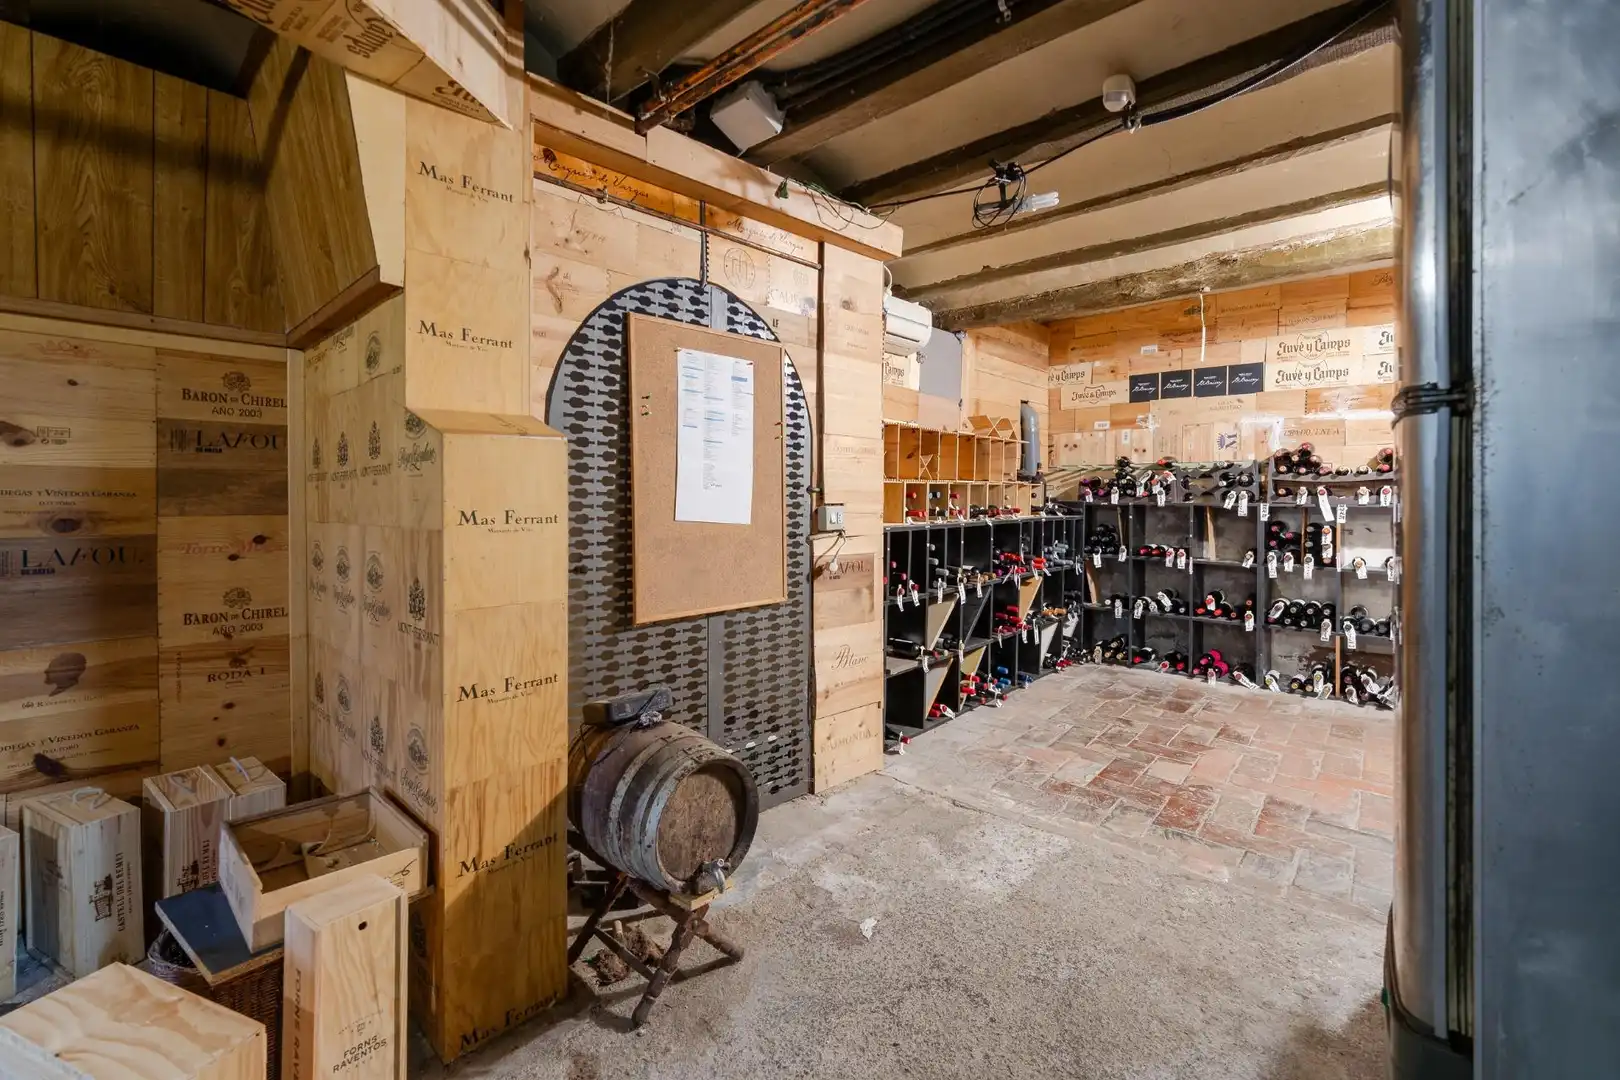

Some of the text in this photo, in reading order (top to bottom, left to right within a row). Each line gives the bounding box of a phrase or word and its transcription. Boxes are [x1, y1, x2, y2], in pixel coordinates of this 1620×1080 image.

[418, 160, 454, 185] Mas
[460, 174, 514, 203] Ferrant
[418, 319, 454, 340] Mas
[461, 327, 514, 349] Ferrant
[1276, 337, 1351, 357] Juvé y Camps
[1061, 369, 1086, 382] Camps
[1275, 369, 1303, 384] Juvé
[1304, 371, 1311, 382] y
[1313, 366, 1350, 381] Camps
[181, 388, 229, 404] BARON
[240, 393, 288, 409] CHIREL
[211, 406, 263, 419] AÑO 2003
[457, 509, 559, 526] Mas Ferrant
[183, 611, 229, 626] BARON
[241, 607, 289, 621] CHIREL
[212, 622, 264, 636] AÑO 2003
[832, 643, 870, 671] Blanc
[207, 670, 252, 683] RODA
[456, 683, 496, 703] Mas
[503, 673, 559, 693] Ferrant
[456, 856, 496, 879] Mas
[503, 832, 558, 860] Ferrant
[343, 1035, 378, 1058] FORNS
[459, 1024, 499, 1050] Mas
